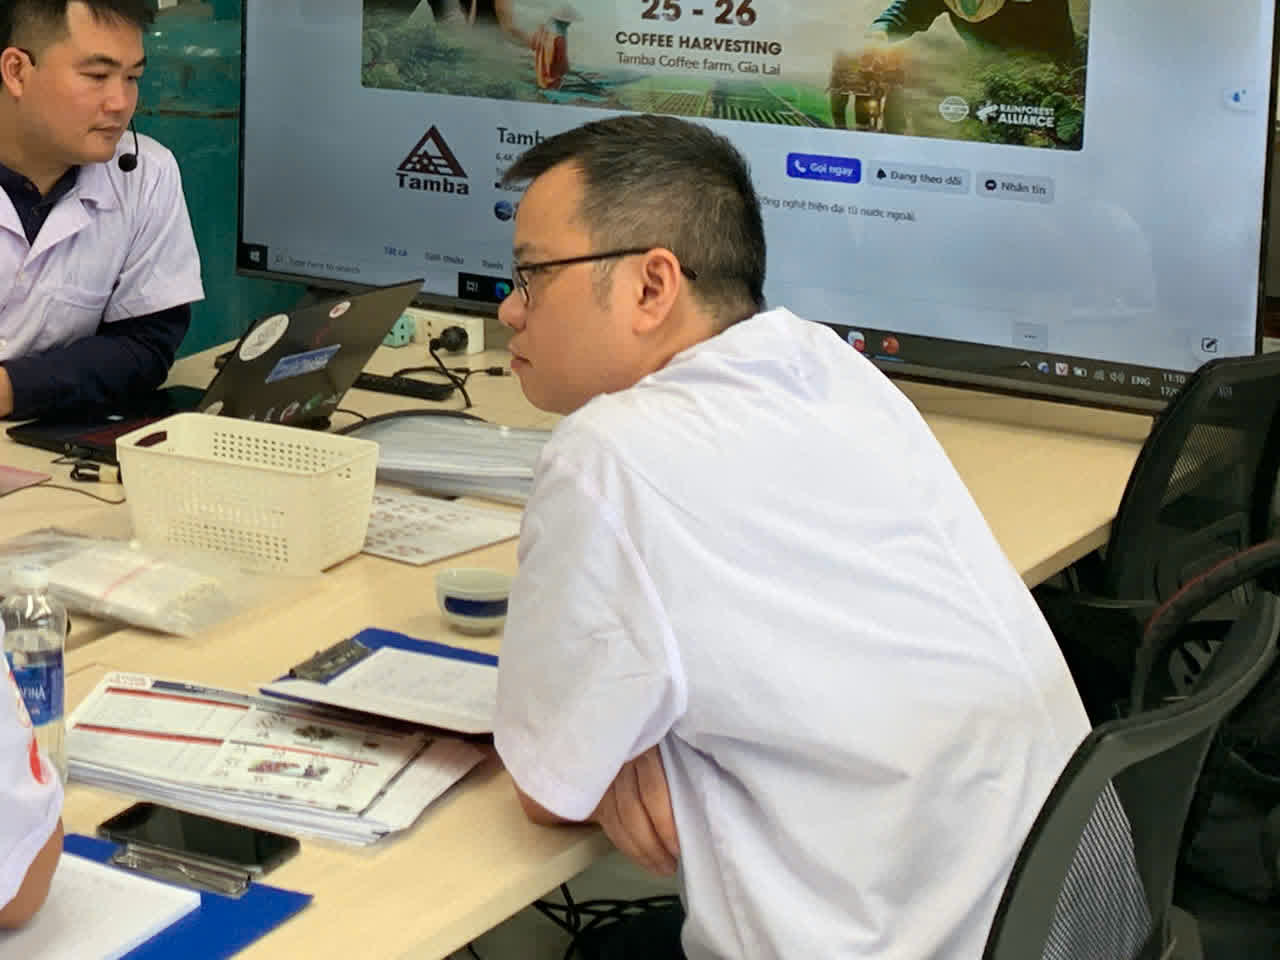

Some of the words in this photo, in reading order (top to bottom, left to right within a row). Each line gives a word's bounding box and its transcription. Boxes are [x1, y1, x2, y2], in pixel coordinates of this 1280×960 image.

[615, 31, 674, 48] COFFEE
[679, 35, 782, 56] HARVESTING
[616, 51, 655, 66] Tamba
[659, 55, 700, 69] Coffee
[703, 58, 735, 73] farm,
[737, 61, 759, 74] Gia
[762, 63, 781, 76] Lai
[998, 103, 1055, 116] RAINFOREST
[997, 113, 1056, 128] ALLIANCE
[496, 126, 544, 145] Tamb
[396, 172, 469, 195] Tamba
[1131, 375, 1151, 387] ENG
[1163, 372, 1186, 385] 11:10
